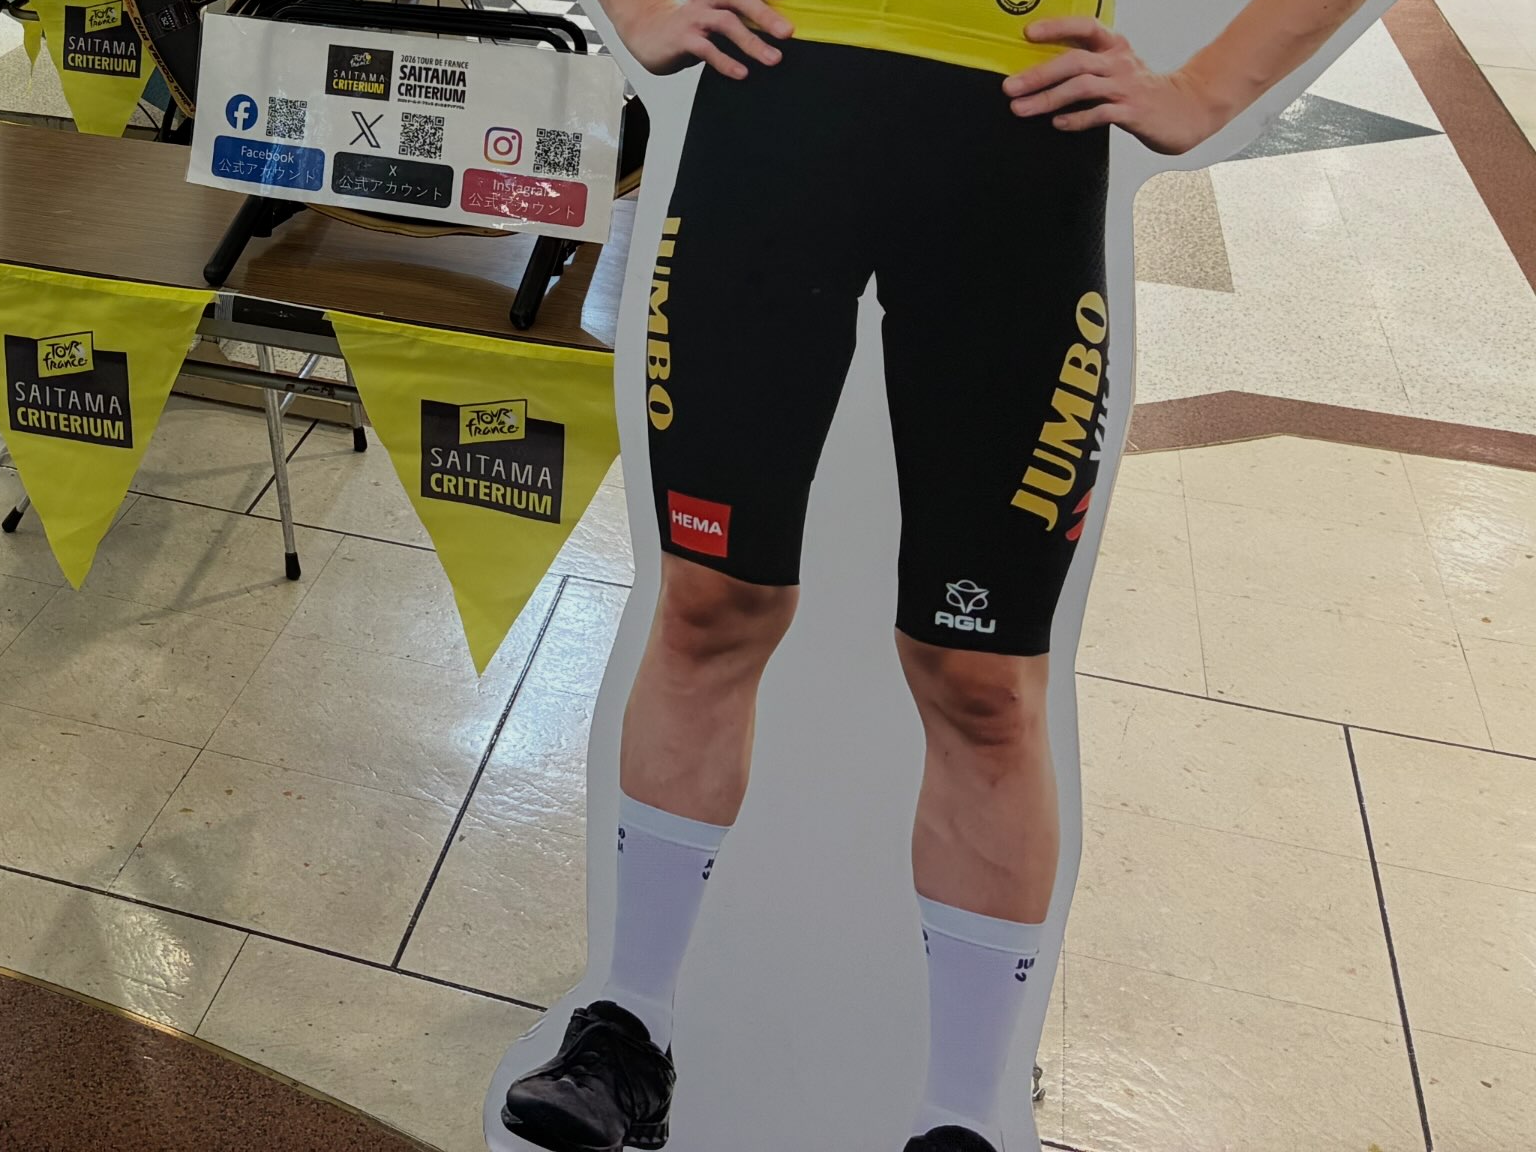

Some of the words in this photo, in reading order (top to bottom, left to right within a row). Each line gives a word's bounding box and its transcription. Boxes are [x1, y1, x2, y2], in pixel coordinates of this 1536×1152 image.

[67, 35, 137, 58] SAITAMA
[67, 52, 137, 74] CRITERIUM
[400, 54, 416, 64] 2026
[417, 56, 434, 66] TOUR
[435, 57, 443, 66] DE
[444, 59, 469, 70] FRANCE
[332, 78, 385, 95] CRITERIUM
[333, 68, 385, 83] SAITAMA
[399, 64, 467, 88] SAITAMA
[397, 82, 467, 104] CRITERIUM
[240, 144, 295, 164] Facebook
[218, 158, 317, 184] 公式アカウント
[388, 164, 398, 178] X
[338, 175, 443, 201] 公式アカウント
[41, 351, 90, 371] france
[14, 380, 123, 417] SAITAMA
[1009, 290, 1109, 533] JUMBO
[16, 406, 126, 442] CRITERIUM
[465, 418, 520, 438] france
[429, 446, 553, 490] SAITAMA
[429, 472, 554, 516] CRITERIUM
[670, 509, 724, 536] HEMA
[934, 610, 996, 634] AGU
